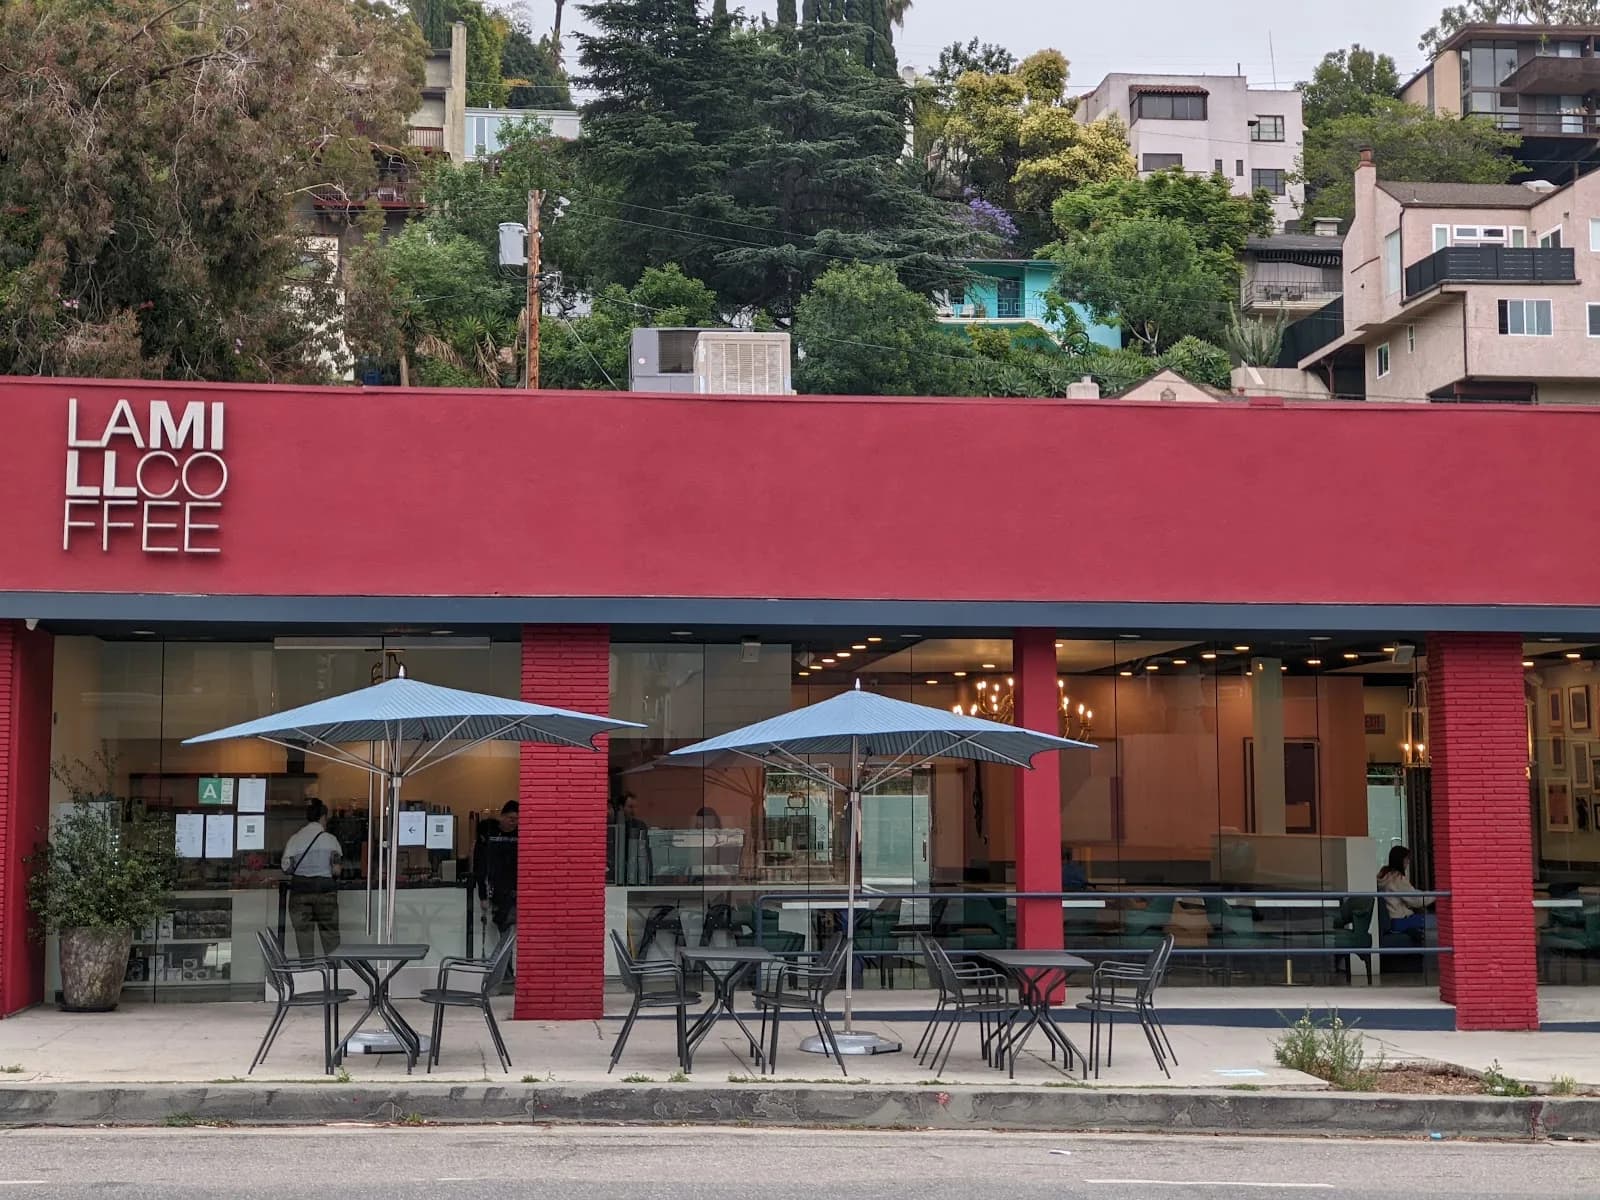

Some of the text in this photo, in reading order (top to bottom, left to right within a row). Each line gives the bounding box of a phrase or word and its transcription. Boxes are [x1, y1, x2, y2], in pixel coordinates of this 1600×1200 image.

[68, 399, 224, 450] LAMI
[63, 499, 222, 552] FFEE
[203, 784, 217, 799] A
